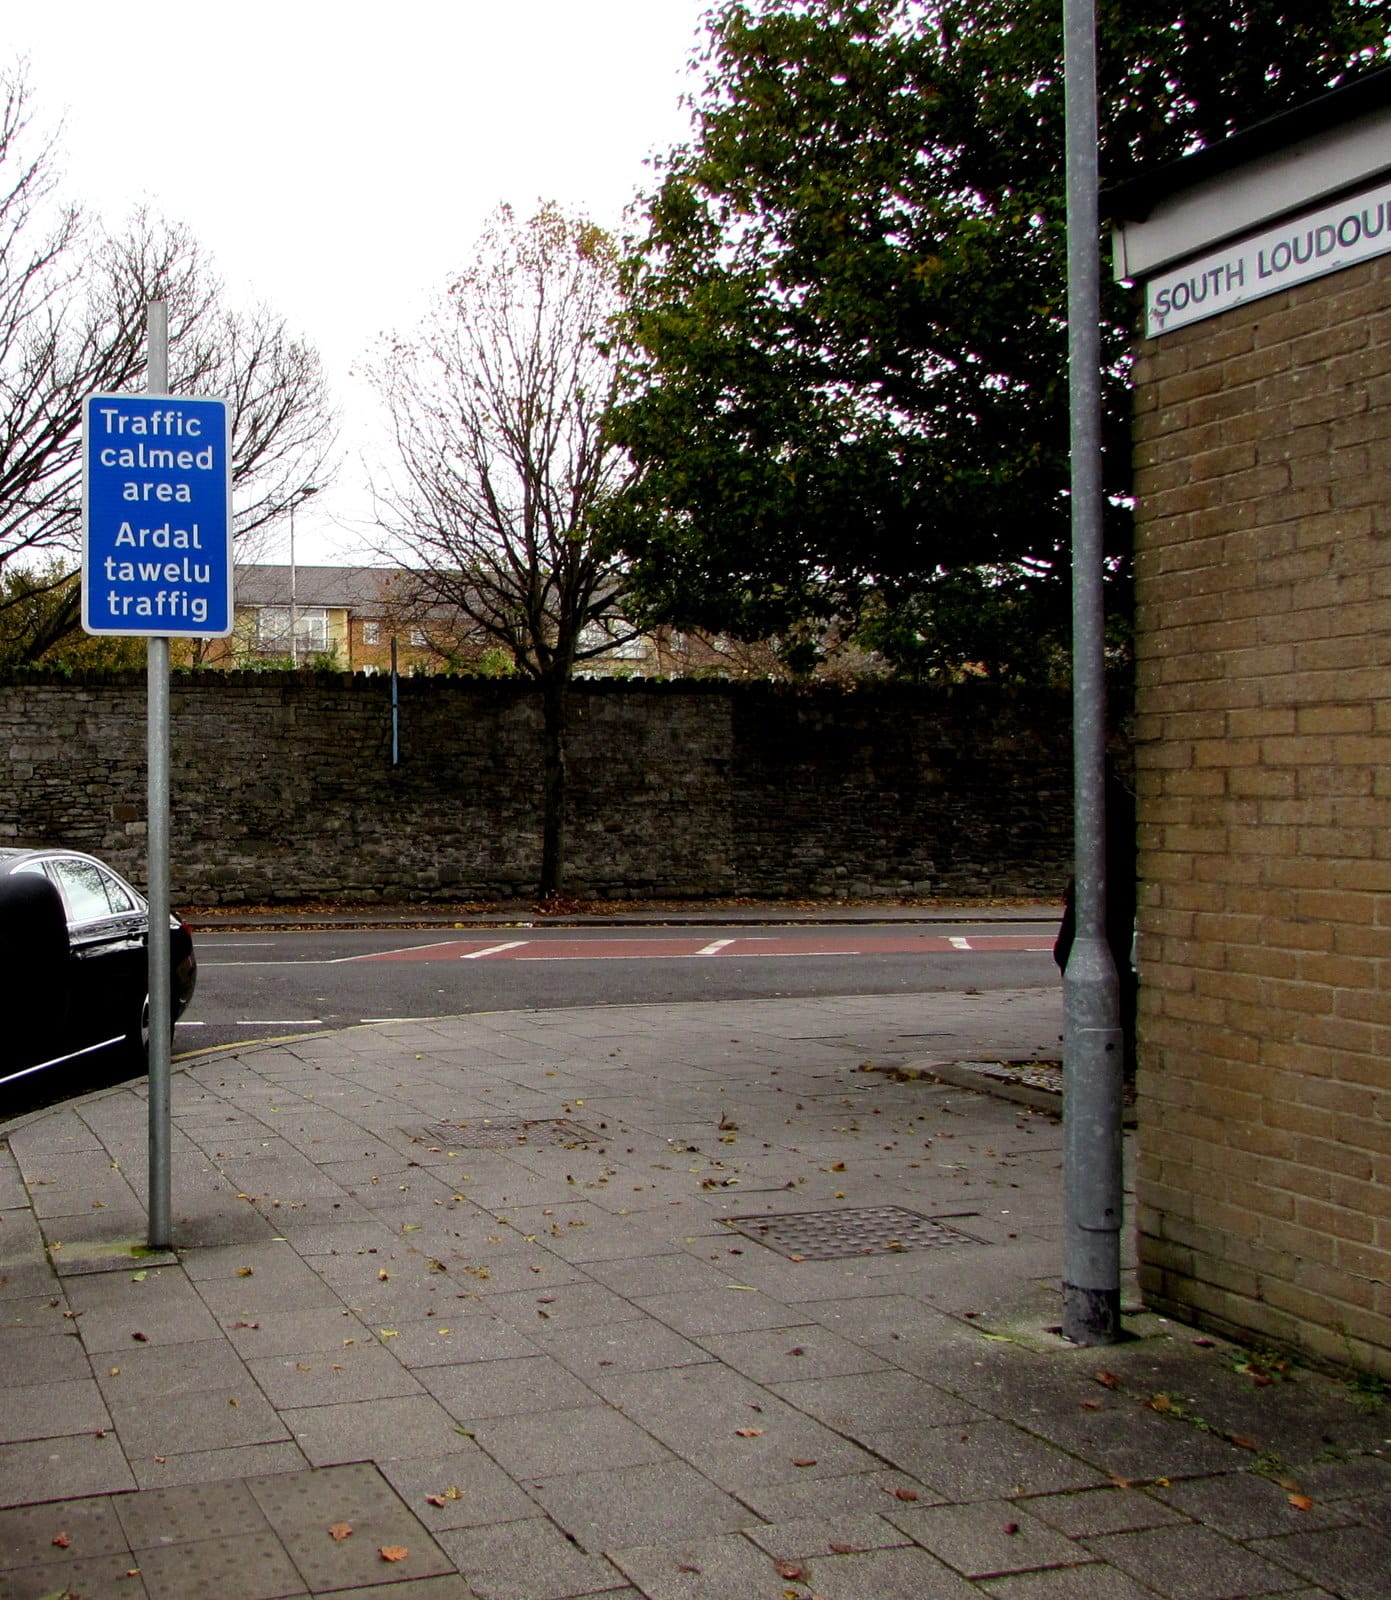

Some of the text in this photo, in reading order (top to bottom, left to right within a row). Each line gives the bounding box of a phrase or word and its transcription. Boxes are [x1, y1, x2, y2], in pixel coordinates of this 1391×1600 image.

[1153, 201, 1391, 317] SOUTH LOUDOU
[100, 409, 201, 436] Traffic
[100, 444, 213, 470] calmed
[122, 482, 191, 503] area
[115, 522, 202, 549] Ardal
[104, 556, 210, 583] tawelu
[107, 591, 208, 622] traffig
